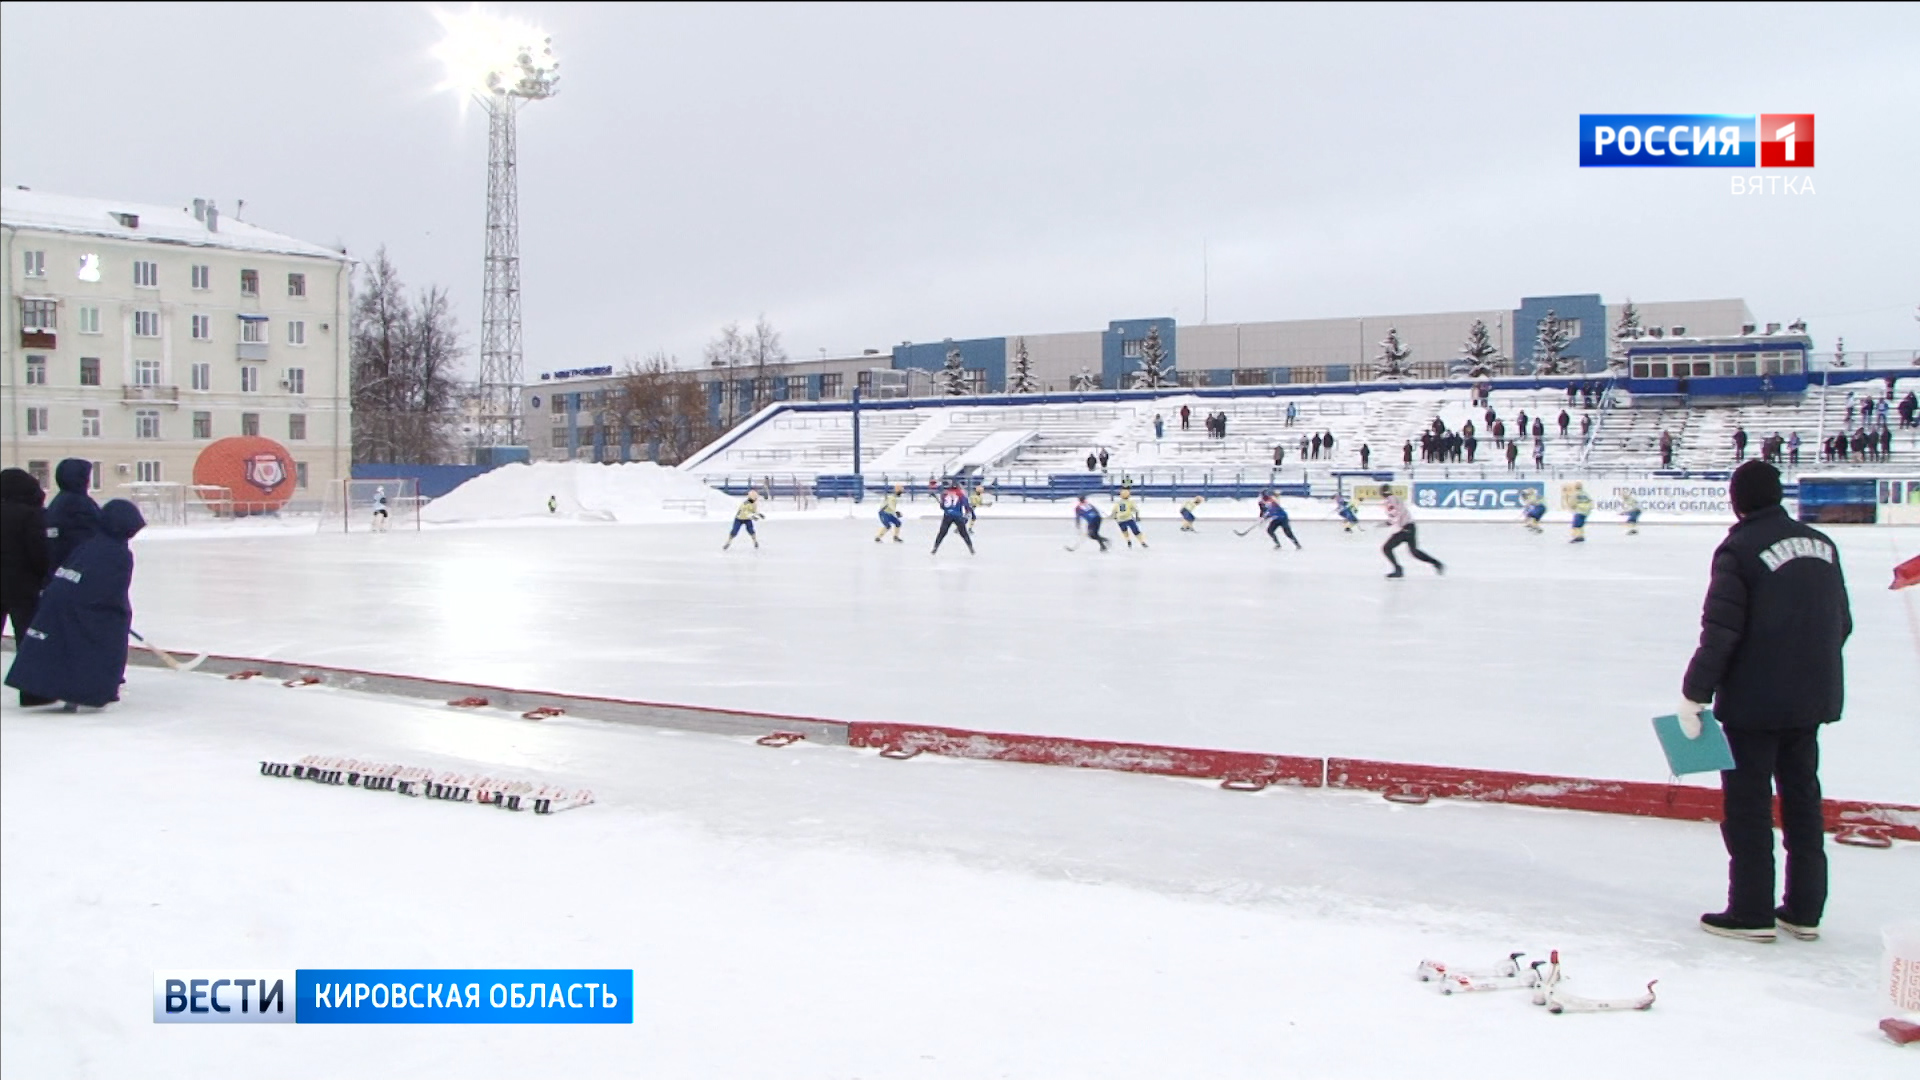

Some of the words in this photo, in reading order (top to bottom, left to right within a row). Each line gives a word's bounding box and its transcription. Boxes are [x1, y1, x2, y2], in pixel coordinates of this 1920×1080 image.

[1612, 487, 1727, 496] ПРАВИТЕЛЬСТВО
[1679, 501, 1733, 511] ОБЛАСТ
[1759, 537, 1833, 572] REFEREE
